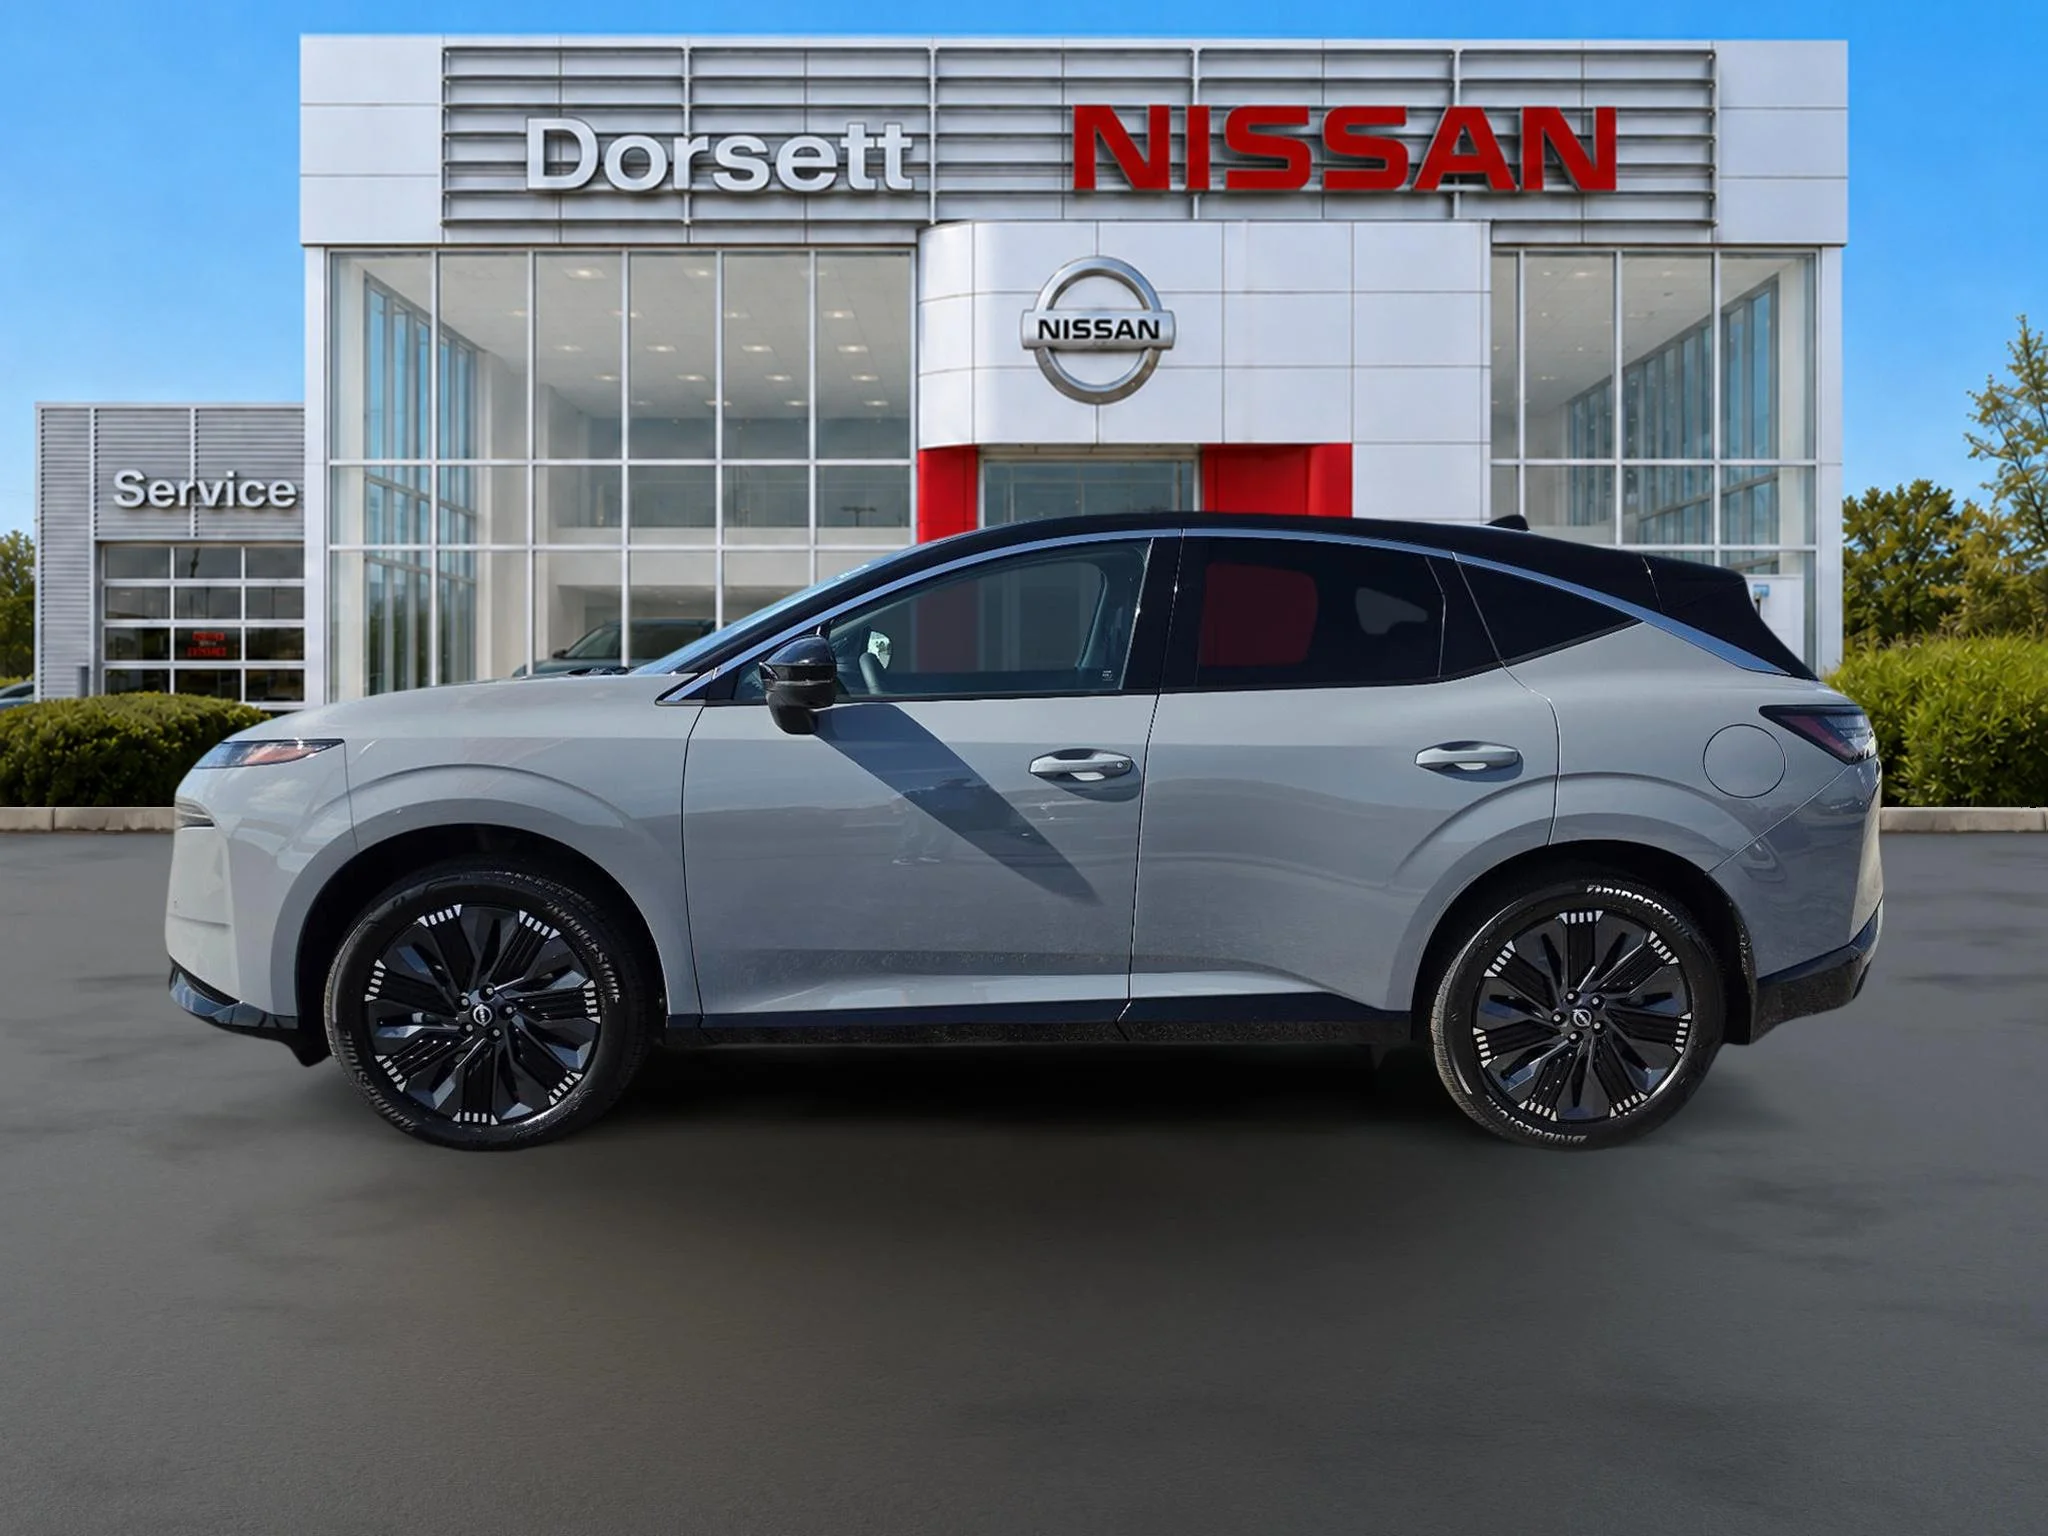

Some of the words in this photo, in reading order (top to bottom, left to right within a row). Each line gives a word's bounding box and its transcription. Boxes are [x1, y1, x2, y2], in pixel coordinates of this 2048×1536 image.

[526, 117, 913, 191] Dorsett
[1072, 104, 1617, 191] NISSAN
[1038, 319, 1160, 340] NISSAN
[113, 469, 297, 508] Service
